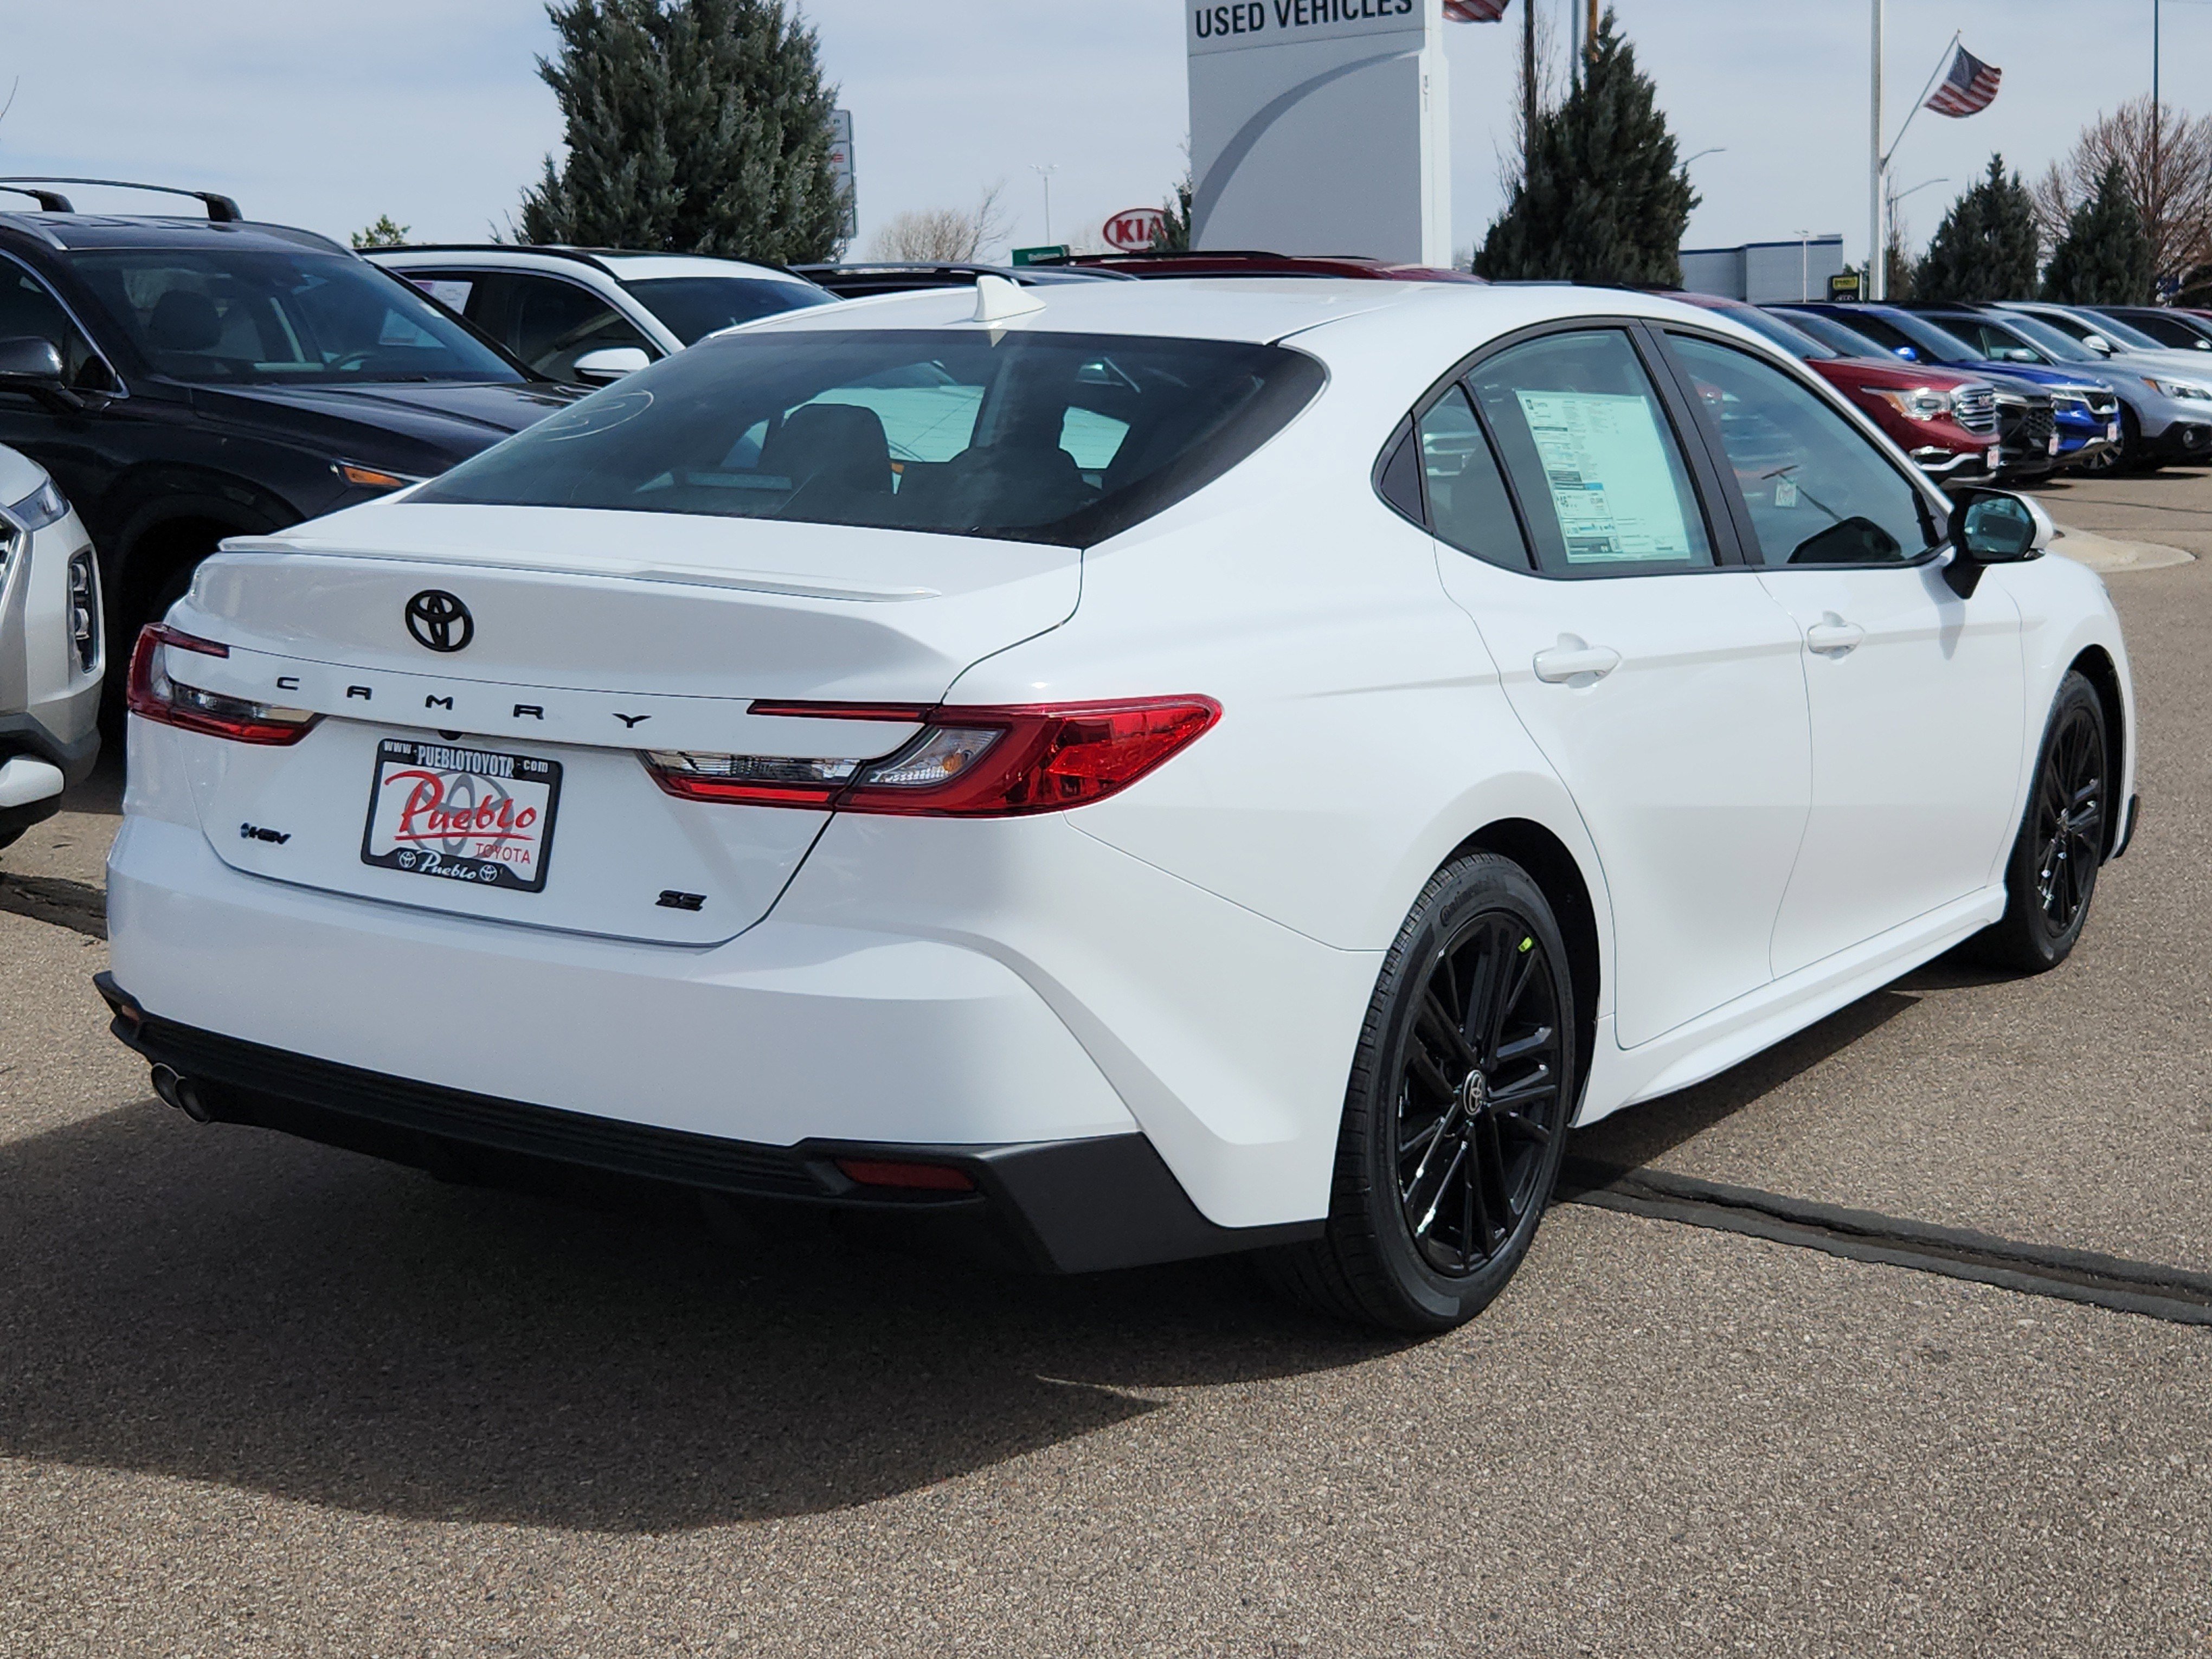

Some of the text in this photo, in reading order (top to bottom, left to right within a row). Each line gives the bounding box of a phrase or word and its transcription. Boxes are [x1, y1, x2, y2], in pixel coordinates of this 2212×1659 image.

[1195, 2, 1265, 38] USED
[1115, 217, 1167, 242] KIA
[276, 677, 652, 729] CAMRY
[384, 770, 537, 833] Pueblo
[416, 850, 477, 880] Pueblo
[475, 843, 531, 865] TOYOTA
[655, 890, 708, 912] SE
